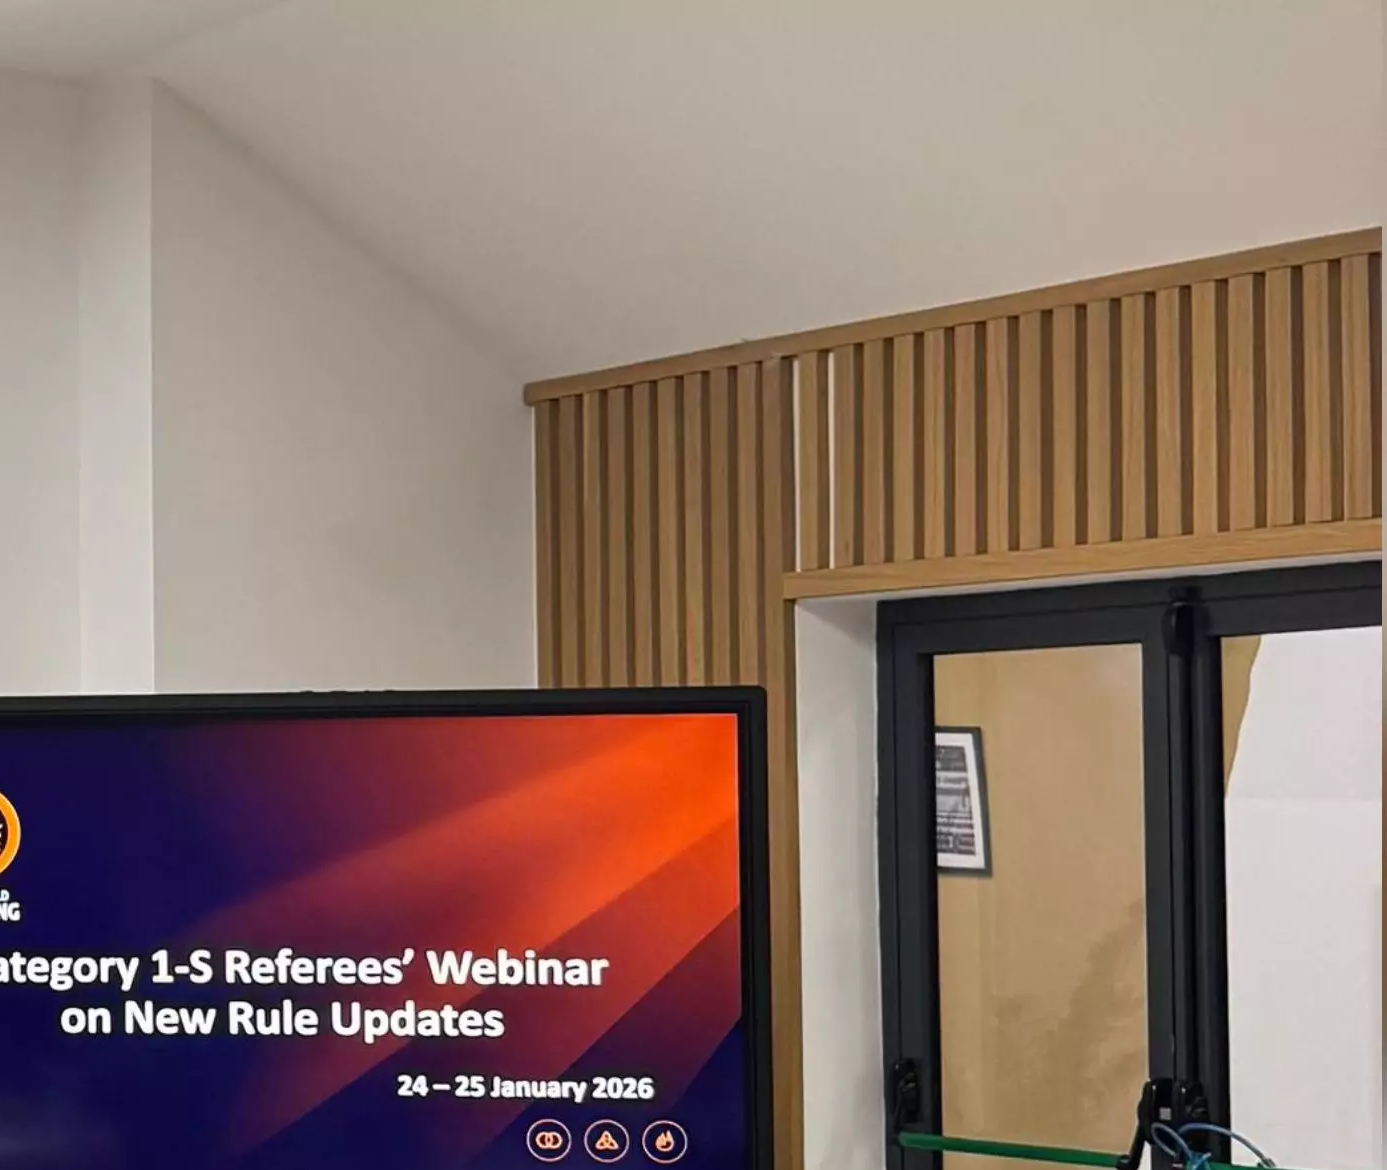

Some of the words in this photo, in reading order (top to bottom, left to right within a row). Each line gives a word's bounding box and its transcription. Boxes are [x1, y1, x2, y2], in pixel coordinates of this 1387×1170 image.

[152, 949, 214, 984] 1-S
[426, 947, 610, 987] Webinar
[60, 1006, 112, 1035] on
[124, 1000, 217, 1035] New
[229, 999, 319, 1036] Rule
[332, 1000, 506, 1045] Updates
[397, 1075, 429, 1097] 24
[455, 1075, 486, 1098] 25
[490, 1076, 588, 1103] January
[591, 1077, 655, 1100] 2026
